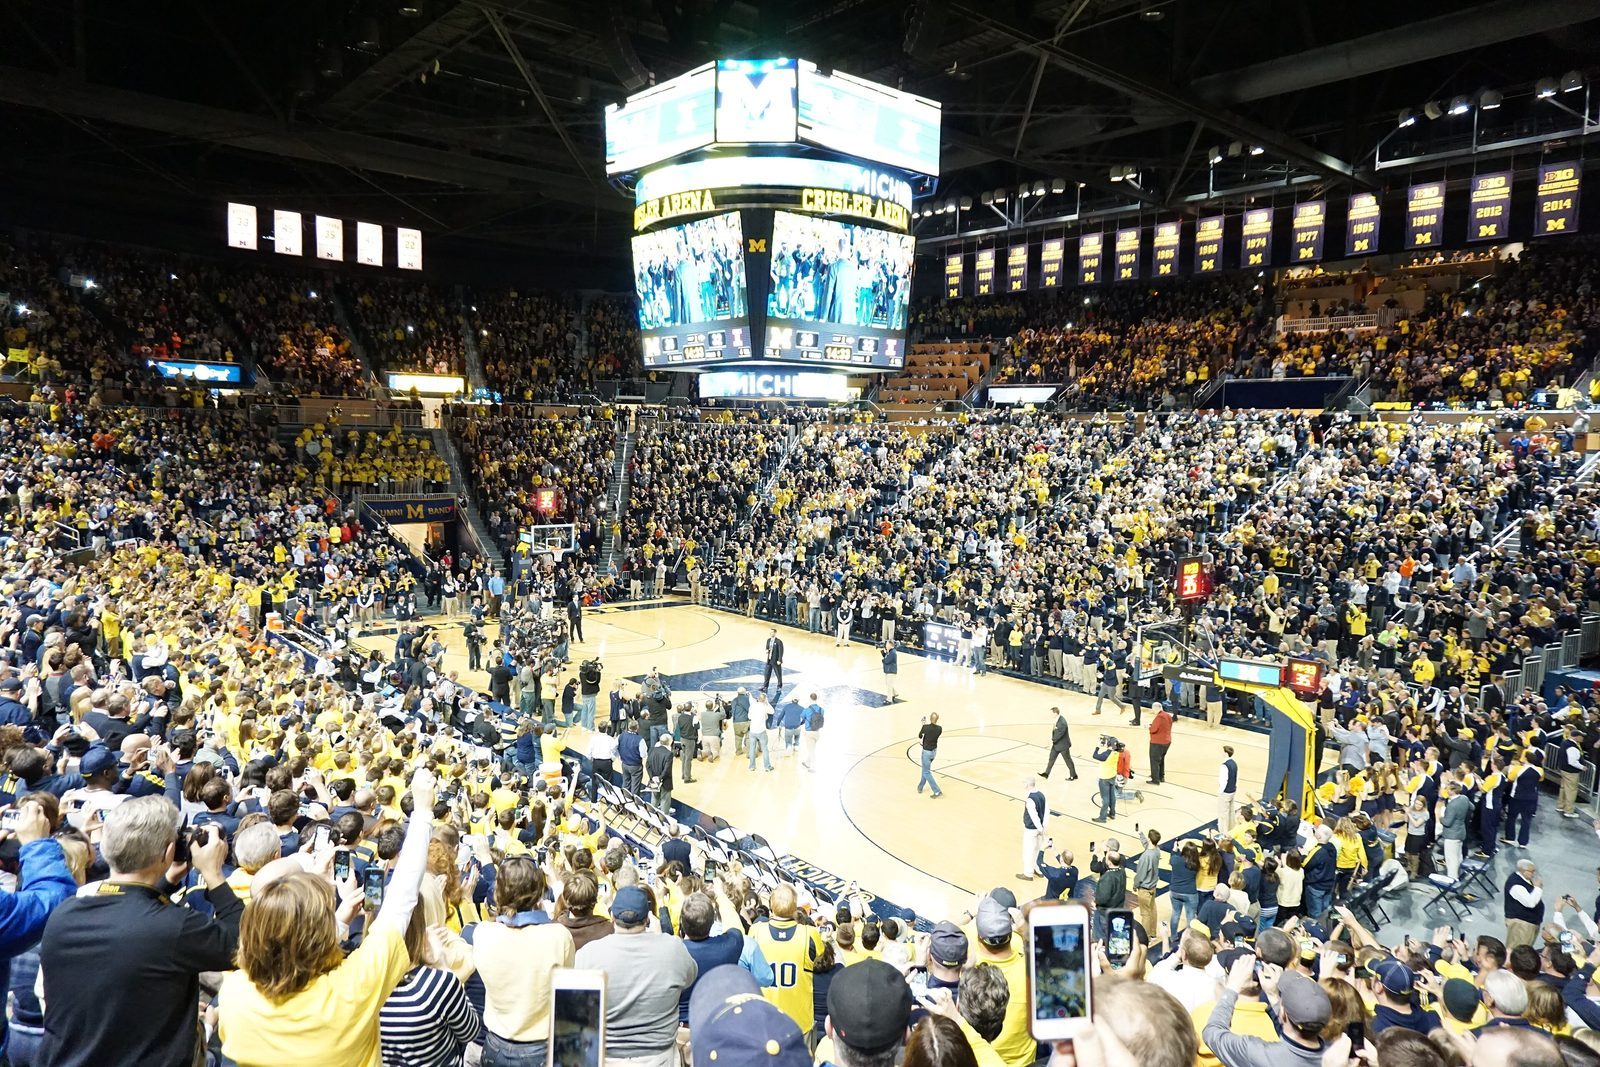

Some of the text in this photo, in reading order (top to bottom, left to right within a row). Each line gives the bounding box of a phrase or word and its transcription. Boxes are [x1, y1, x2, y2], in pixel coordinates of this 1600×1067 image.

[662, 190, 715, 217] ARENA
[802, 189, 872, 217] CRISLER
[1542, 198, 1571, 212] 2014
[1476, 205, 1503, 218] 2012
[1479, 224, 1497, 237] M
[1546, 218, 1565, 231] M
[1246, 237, 1267, 250] 1974
[1296, 231, 1319, 243] 1977
[1415, 232, 1432, 245] M
[748, 239, 766, 253] M
[1354, 239, 1369, 251] M
[1248, 253, 1262, 265] M
[1299, 247, 1314, 259] M
[1159, 264, 1171, 275] M
[1201, 259, 1215, 271] M
[1084, 272, 1095, 282] M
[1121, 268, 1132, 278] M
[405, 504, 425, 519] M
[428, 506, 450, 515] BAND
[769, 962, 797, 988] 10
